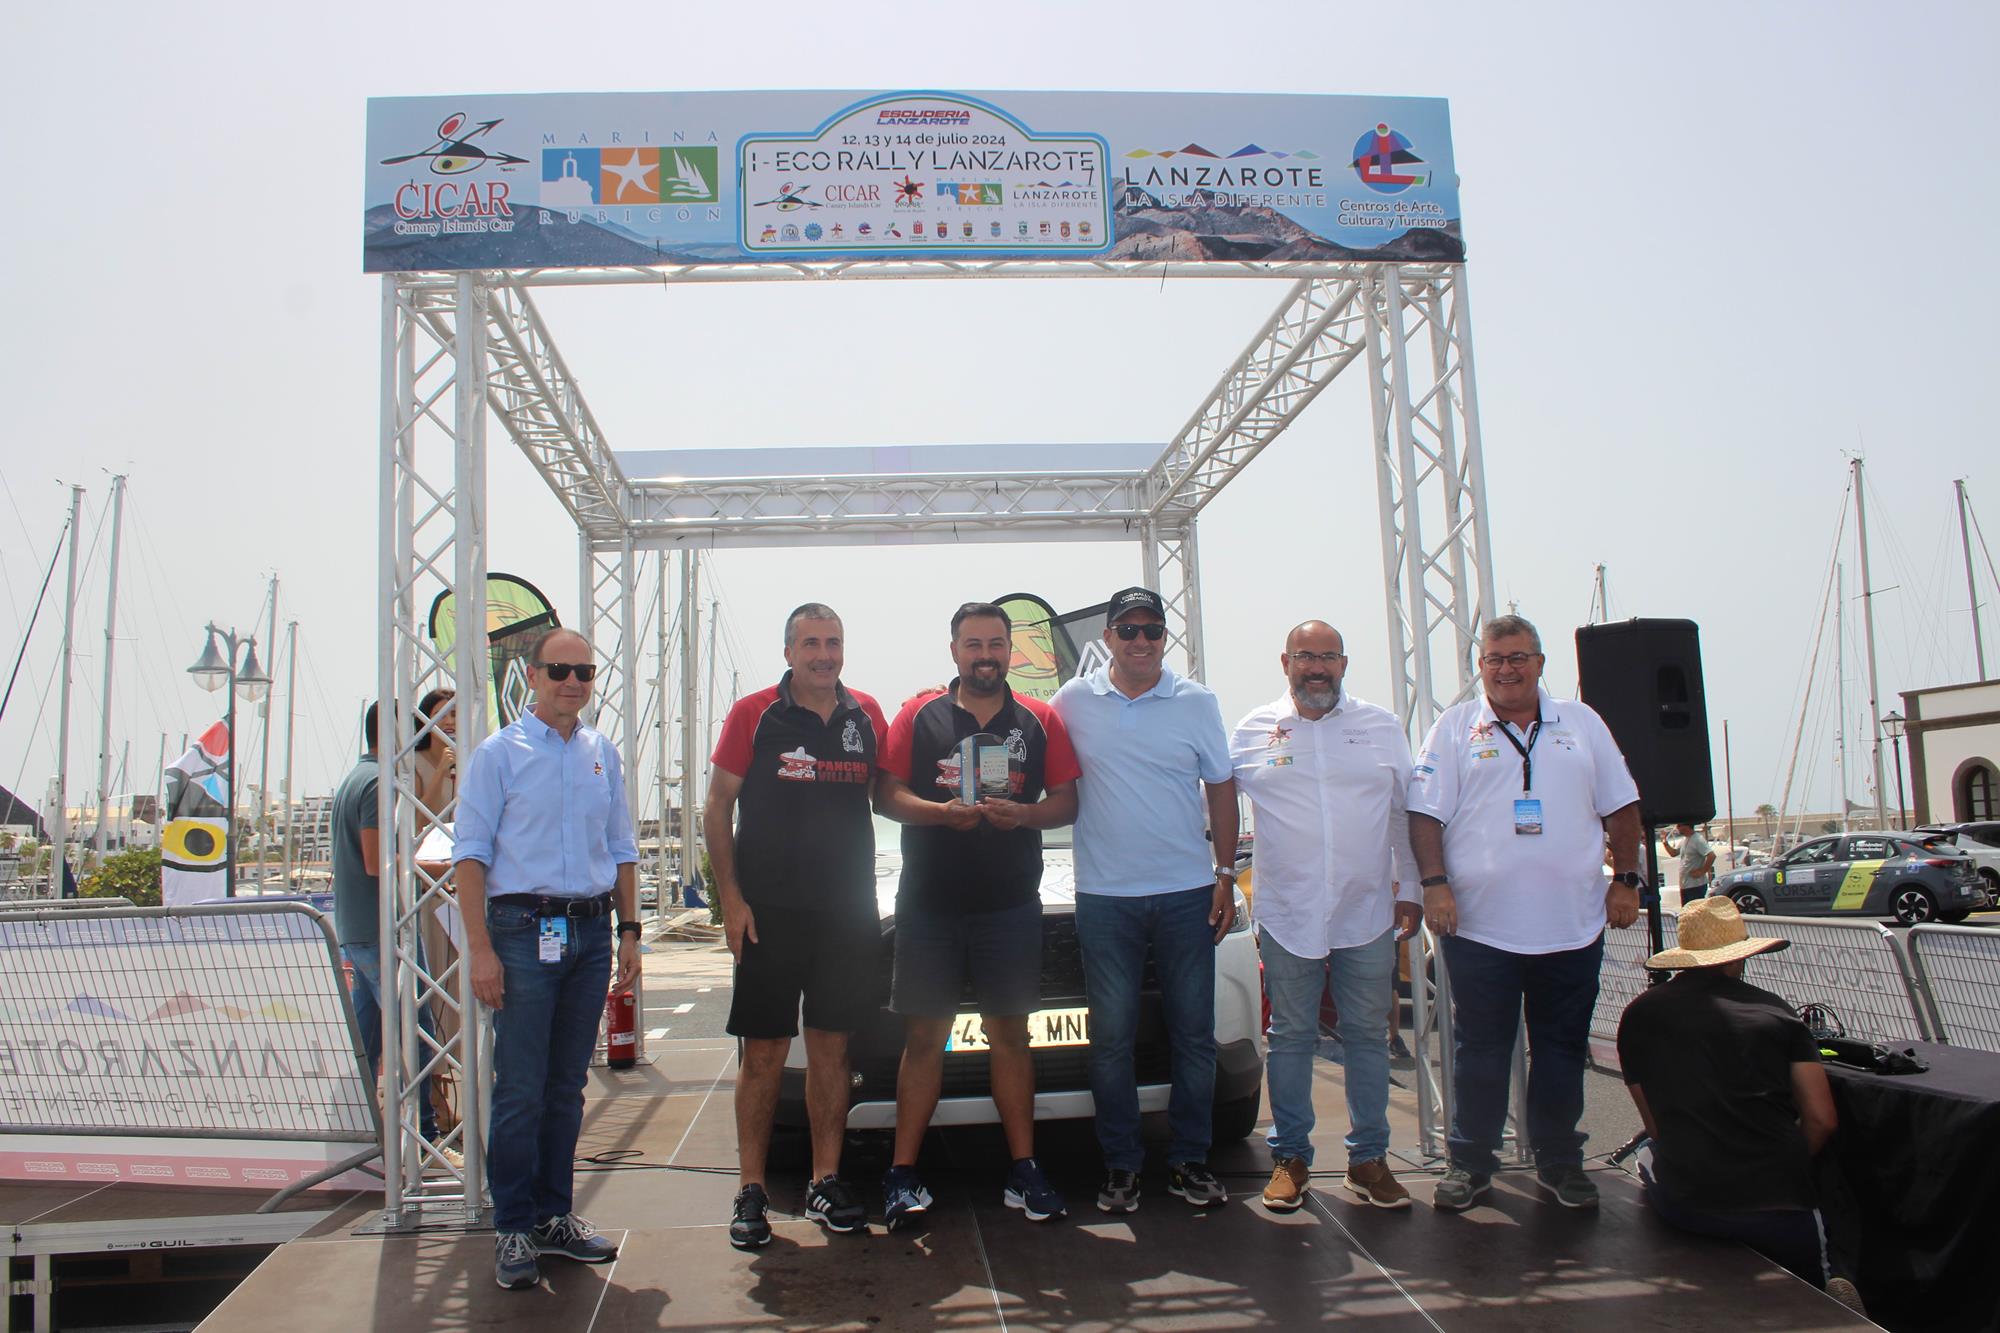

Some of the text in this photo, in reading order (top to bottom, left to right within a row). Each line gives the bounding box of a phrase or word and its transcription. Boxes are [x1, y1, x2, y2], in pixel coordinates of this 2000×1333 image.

[880, 110, 971, 118] ESCUDERIA
[876, 118, 970, 126] LANZAROTE
[542, 131, 718, 145] MARINA
[865, 135, 880, 147] 13
[884, 135, 892, 147] y
[896, 135, 911, 146] 14
[915, 132, 934, 145] de
[937, 132, 968, 147] julio
[972, 135, 1006, 147] 2024
[776, 151, 831, 171] ECO
[838, 151, 925, 171] RALLY
[932, 151, 1094, 171] LANZAROTE
[1124, 166, 1324, 187] LANZAROTE
[825, 184, 880, 202] CICAR
[1013, 191, 1097, 200] LANZAROTE
[1125, 193, 1326, 207] LA ISLA DIFERENTE
[395, 182, 513, 219] CICAR
[1339, 200, 1443, 214] Centros de Arte,
[540, 207, 720, 225] RUBICÓN
[1337, 214, 1446, 230] Cultura y Turismo
[395, 218, 514, 236] Canary Islands Car
[817, 760, 868, 773] PANCHO
[1776, 871, 1784, 884] 8
[149, 1240, 195, 1248] GUIL
